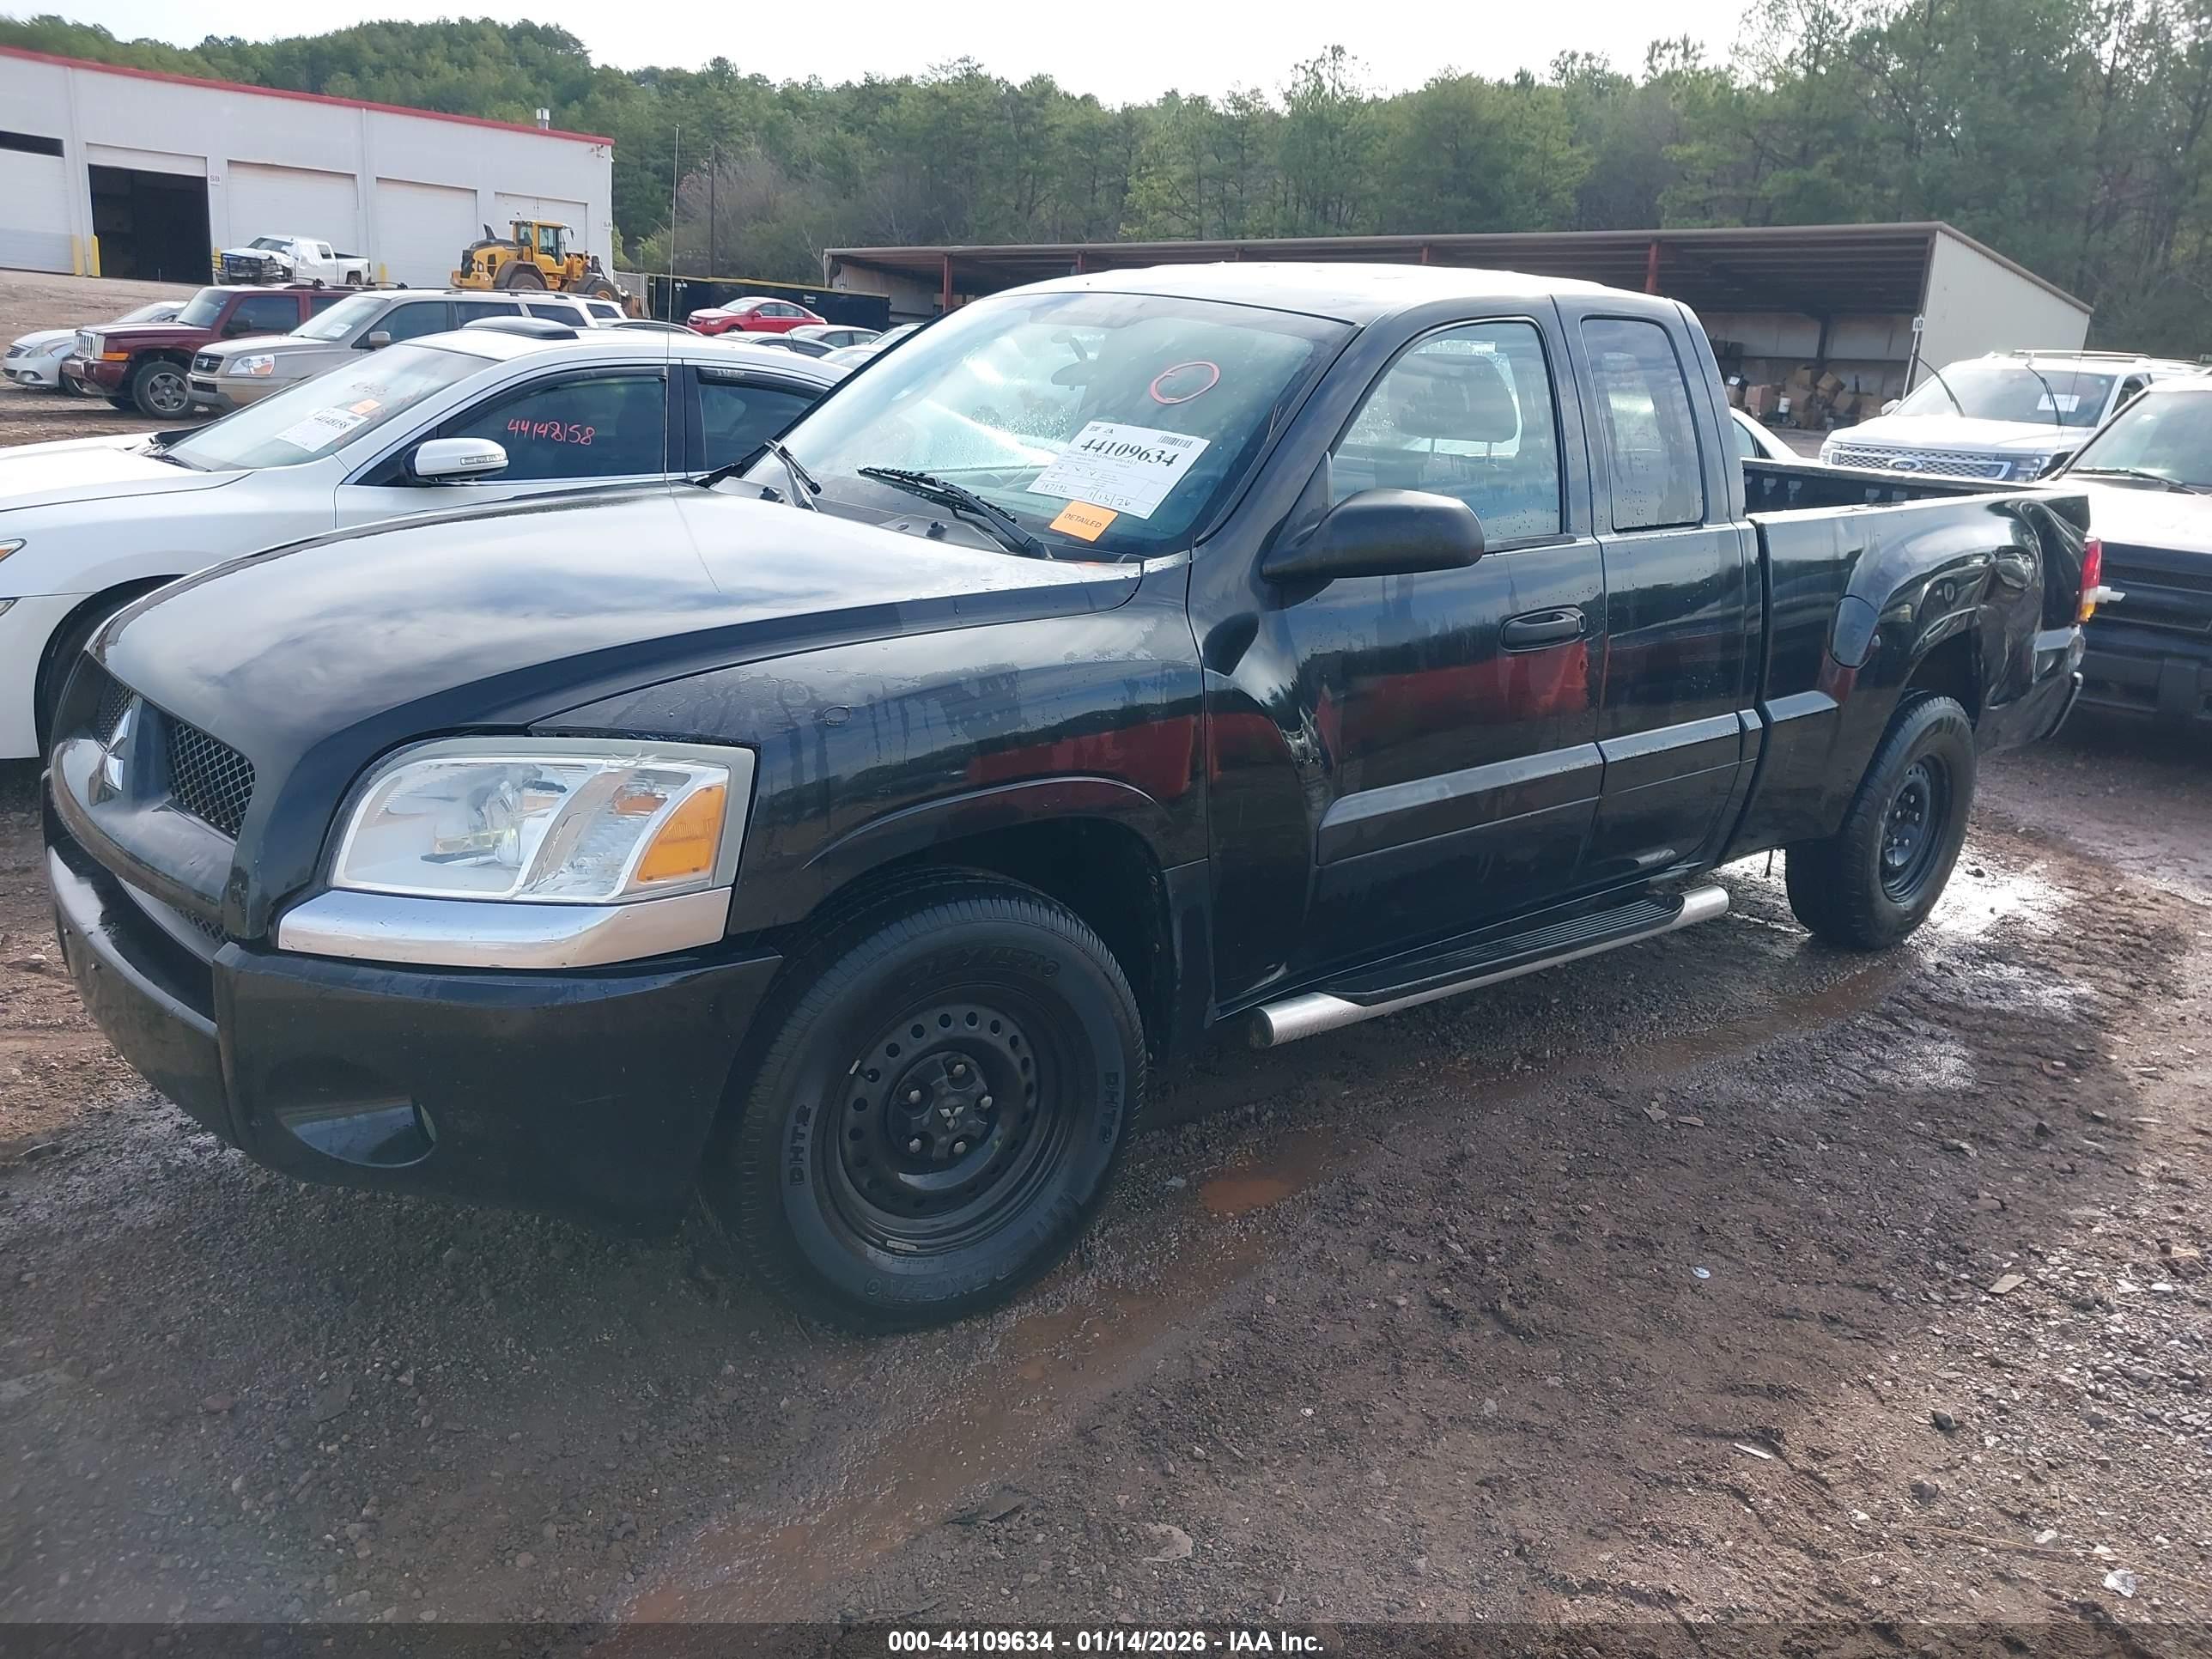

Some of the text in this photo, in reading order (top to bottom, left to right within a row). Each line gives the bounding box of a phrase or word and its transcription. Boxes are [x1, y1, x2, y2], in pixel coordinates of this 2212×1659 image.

[507, 418, 595, 446] 44148158
[1080, 438, 1179, 467] 44109634
[1064, 513, 1102, 529] DETAILED
[790, 1104, 811, 1186] DHT2
